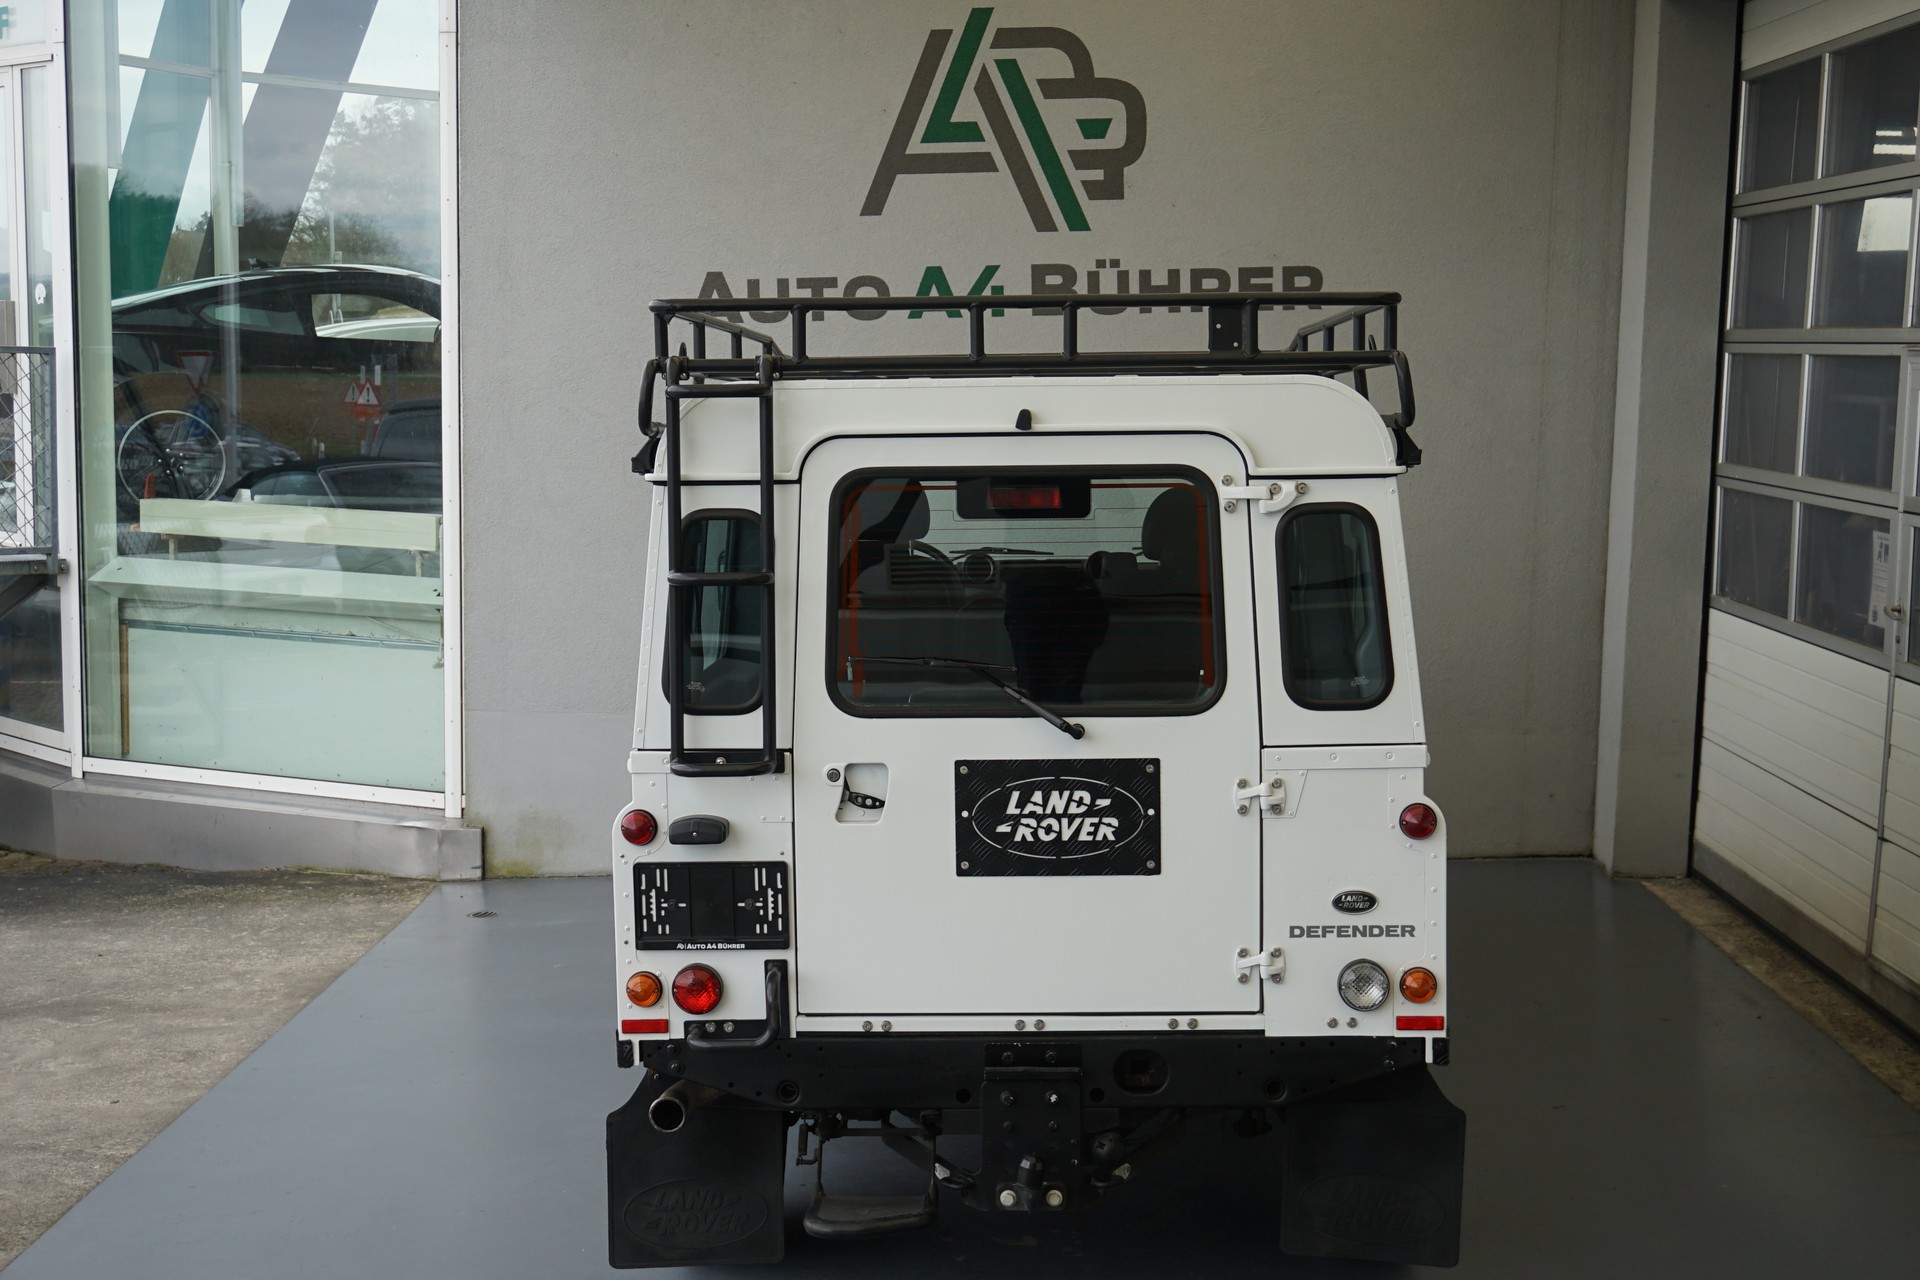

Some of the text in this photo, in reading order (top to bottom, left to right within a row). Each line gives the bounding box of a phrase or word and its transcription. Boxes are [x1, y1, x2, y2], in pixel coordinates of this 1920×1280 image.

[697, 258, 1324, 324] AUTO A4 BÜHRER
[1005, 790, 1092, 815] LAND
[1013, 817, 1120, 842] ROVER
[1341, 894, 1364, 902] LAND
[1342, 901, 1371, 909] ROVER
[1288, 924, 1417, 939] DEFENDER
[686, 942, 706, 950] AUTO
